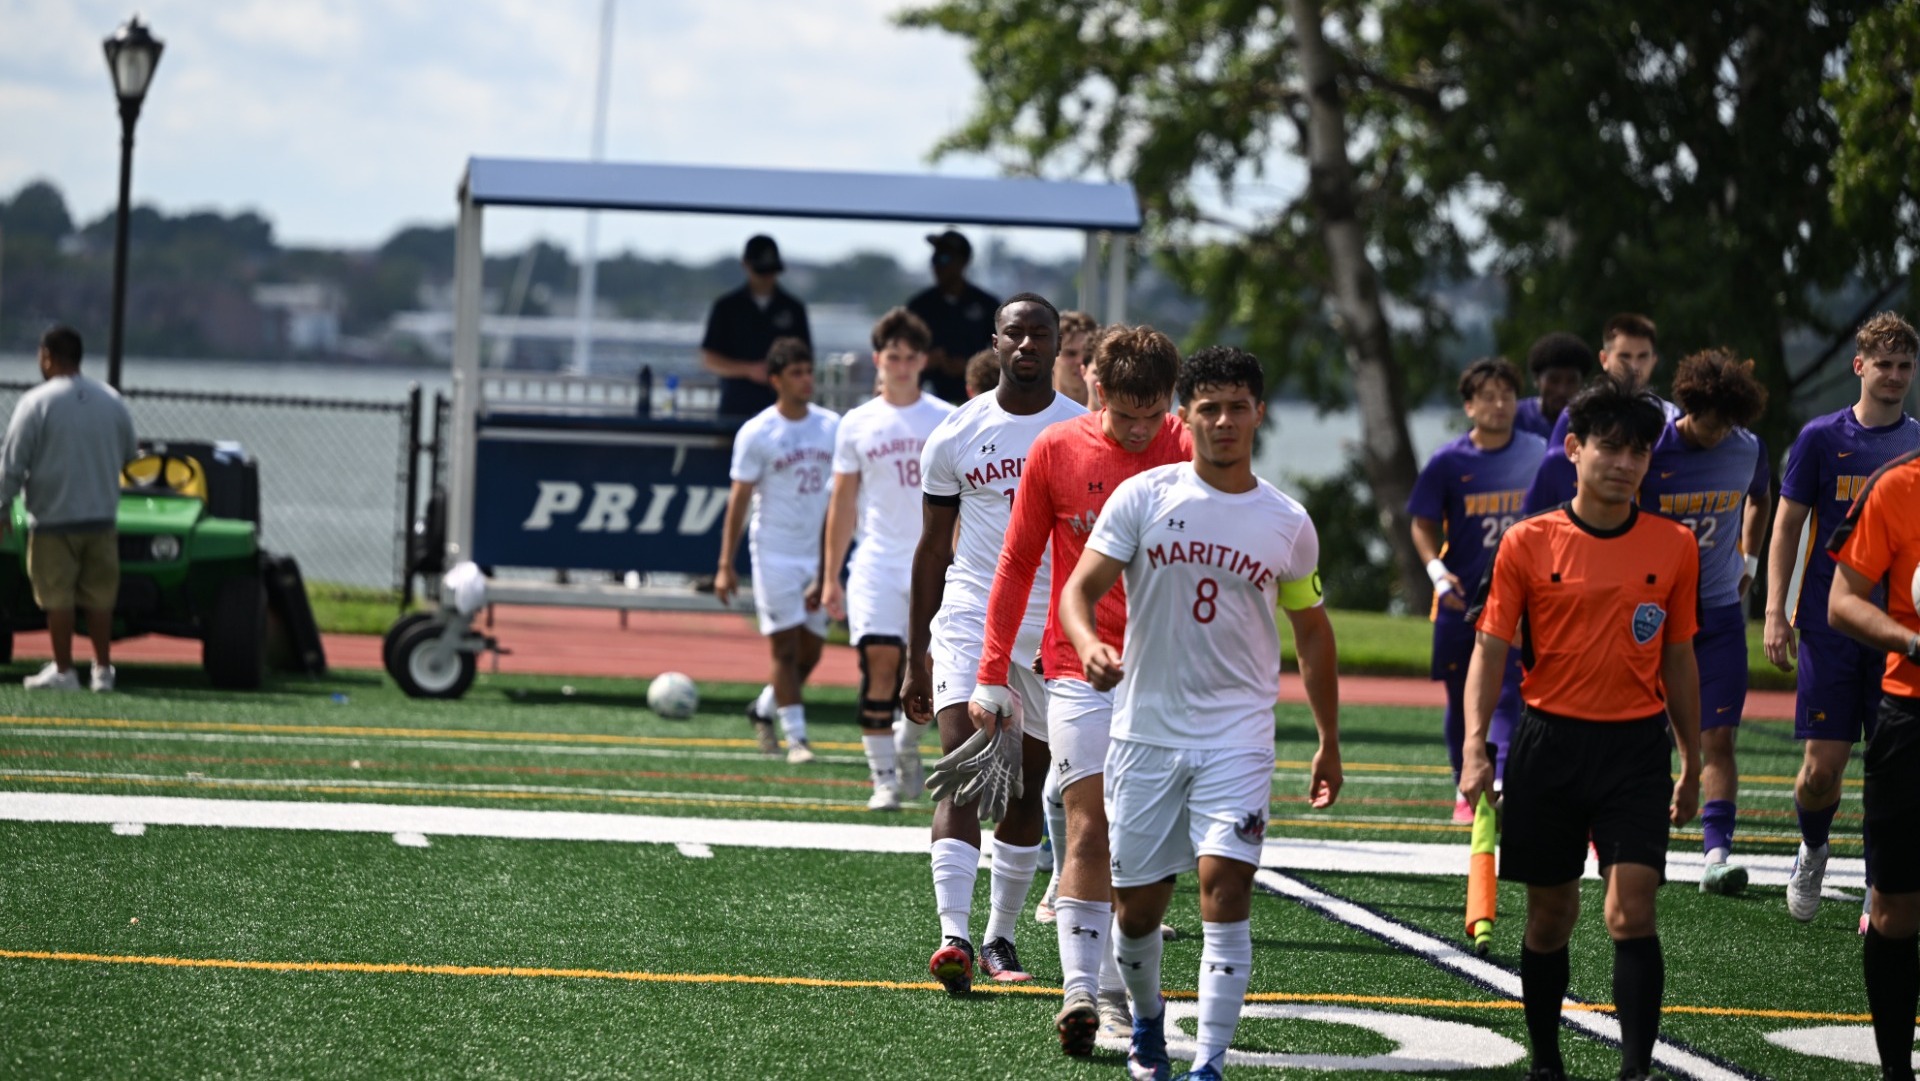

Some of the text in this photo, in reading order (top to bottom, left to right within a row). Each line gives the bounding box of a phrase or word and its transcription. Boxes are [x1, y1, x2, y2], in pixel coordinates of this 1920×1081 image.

[795, 465, 822, 494] 28
[895, 458, 921, 487] 18
[965, 457, 1026, 490] MARI
[522, 480, 735, 535] PRIV
[1659, 490, 1742, 515] HUNTER
[1147, 541, 1273, 592] MARITIME
[1193, 577, 1218, 624] 8
